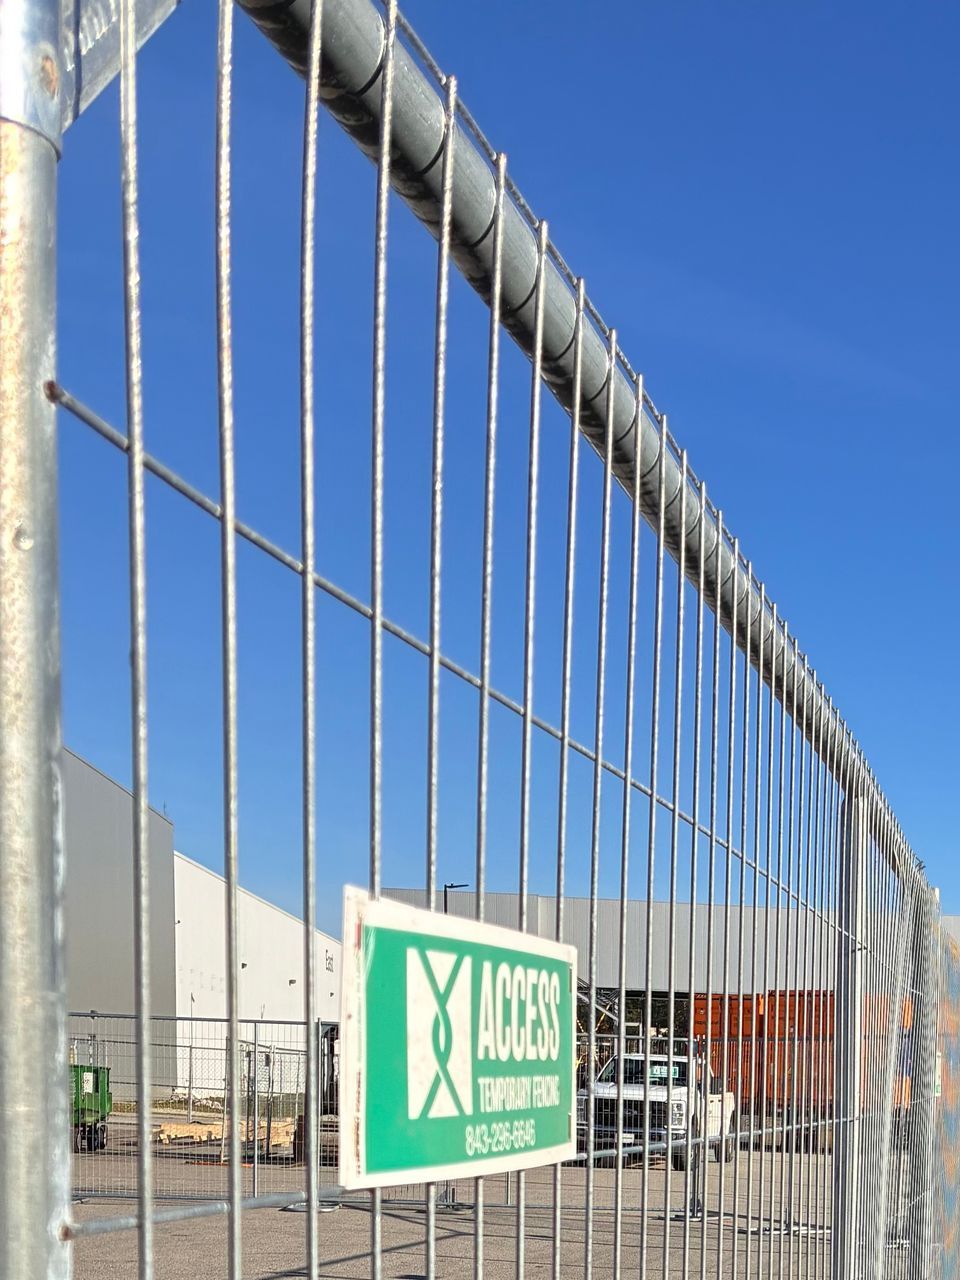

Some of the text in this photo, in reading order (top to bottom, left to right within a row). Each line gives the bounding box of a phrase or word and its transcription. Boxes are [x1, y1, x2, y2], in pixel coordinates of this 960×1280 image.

[478, 961, 561, 1062] ACCESS
[478, 1075, 560, 1112] TEMPORARY FENCING
